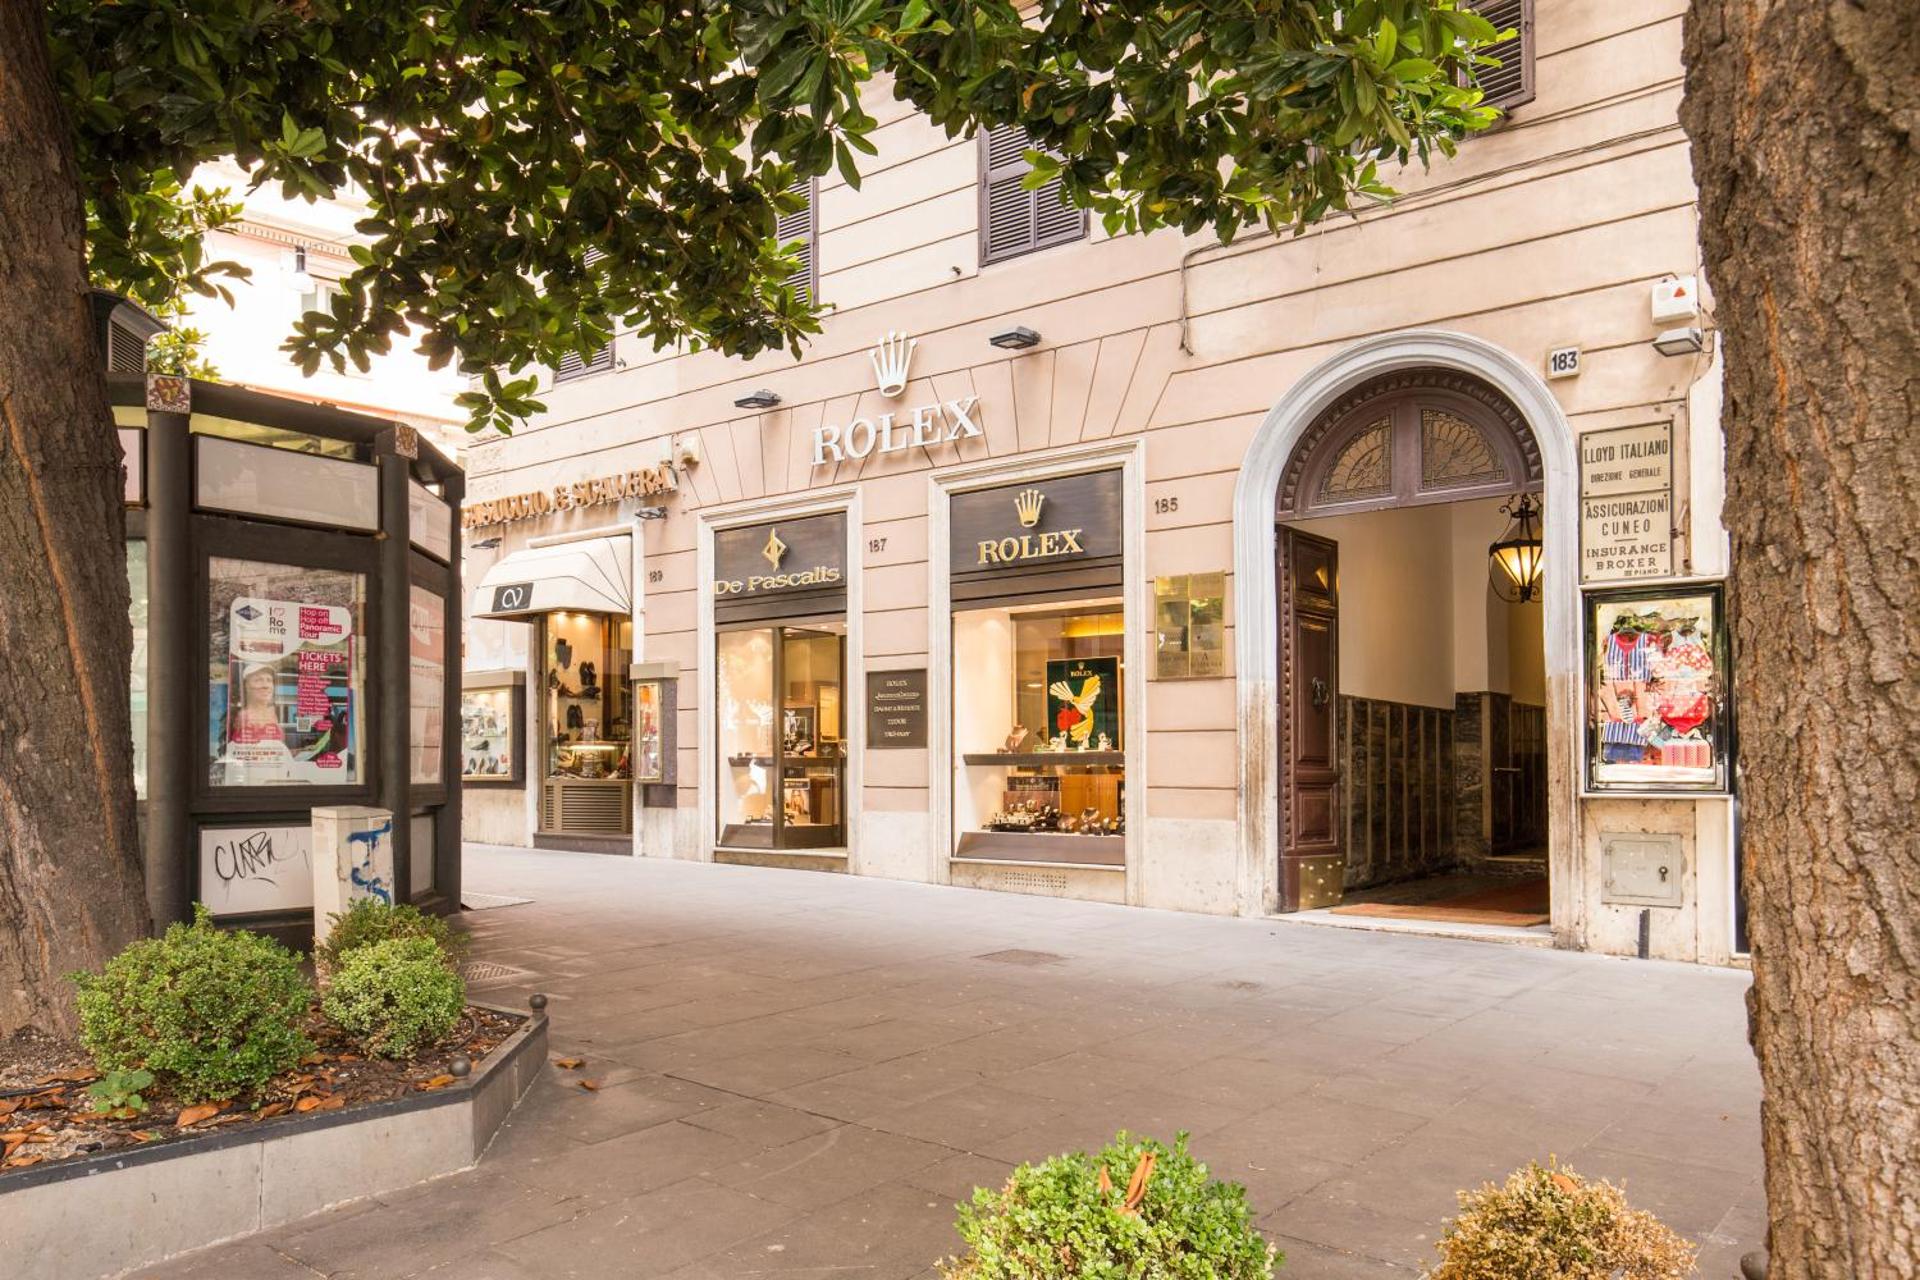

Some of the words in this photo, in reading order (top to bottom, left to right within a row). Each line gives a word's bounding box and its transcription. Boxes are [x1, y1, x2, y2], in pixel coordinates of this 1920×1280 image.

[1551, 351, 1577, 371] 183
[811, 395, 984, 466] ROLEX
[1584, 446, 1615, 464] LLOYD
[1620, 439, 1668, 460] ITALIANO
[1590, 471, 1623, 484] DIREZIONE
[1629, 466, 1661, 479] GENERALE
[553, 485, 574, 512] &
[1154, 497, 1179, 515] 185
[1586, 498, 1669, 520] ASSICURAZIONI
[1602, 518, 1650, 536] CUNEO
[868, 538, 888, 552] 187
[977, 528, 1084, 565] ROLEX
[1586, 543, 1667, 558] INSURANCE
[1596, 557, 1656, 570] BROKER
[713, 579, 743, 596] De
[748, 565, 841, 592] Pascalis
[300, 608, 316, 617] Hop
[300, 623, 341, 633] Panoramic
[300, 630, 319, 638] Tour
[300, 651, 341, 663] TICKETS
[300, 661, 327, 671] HERE
